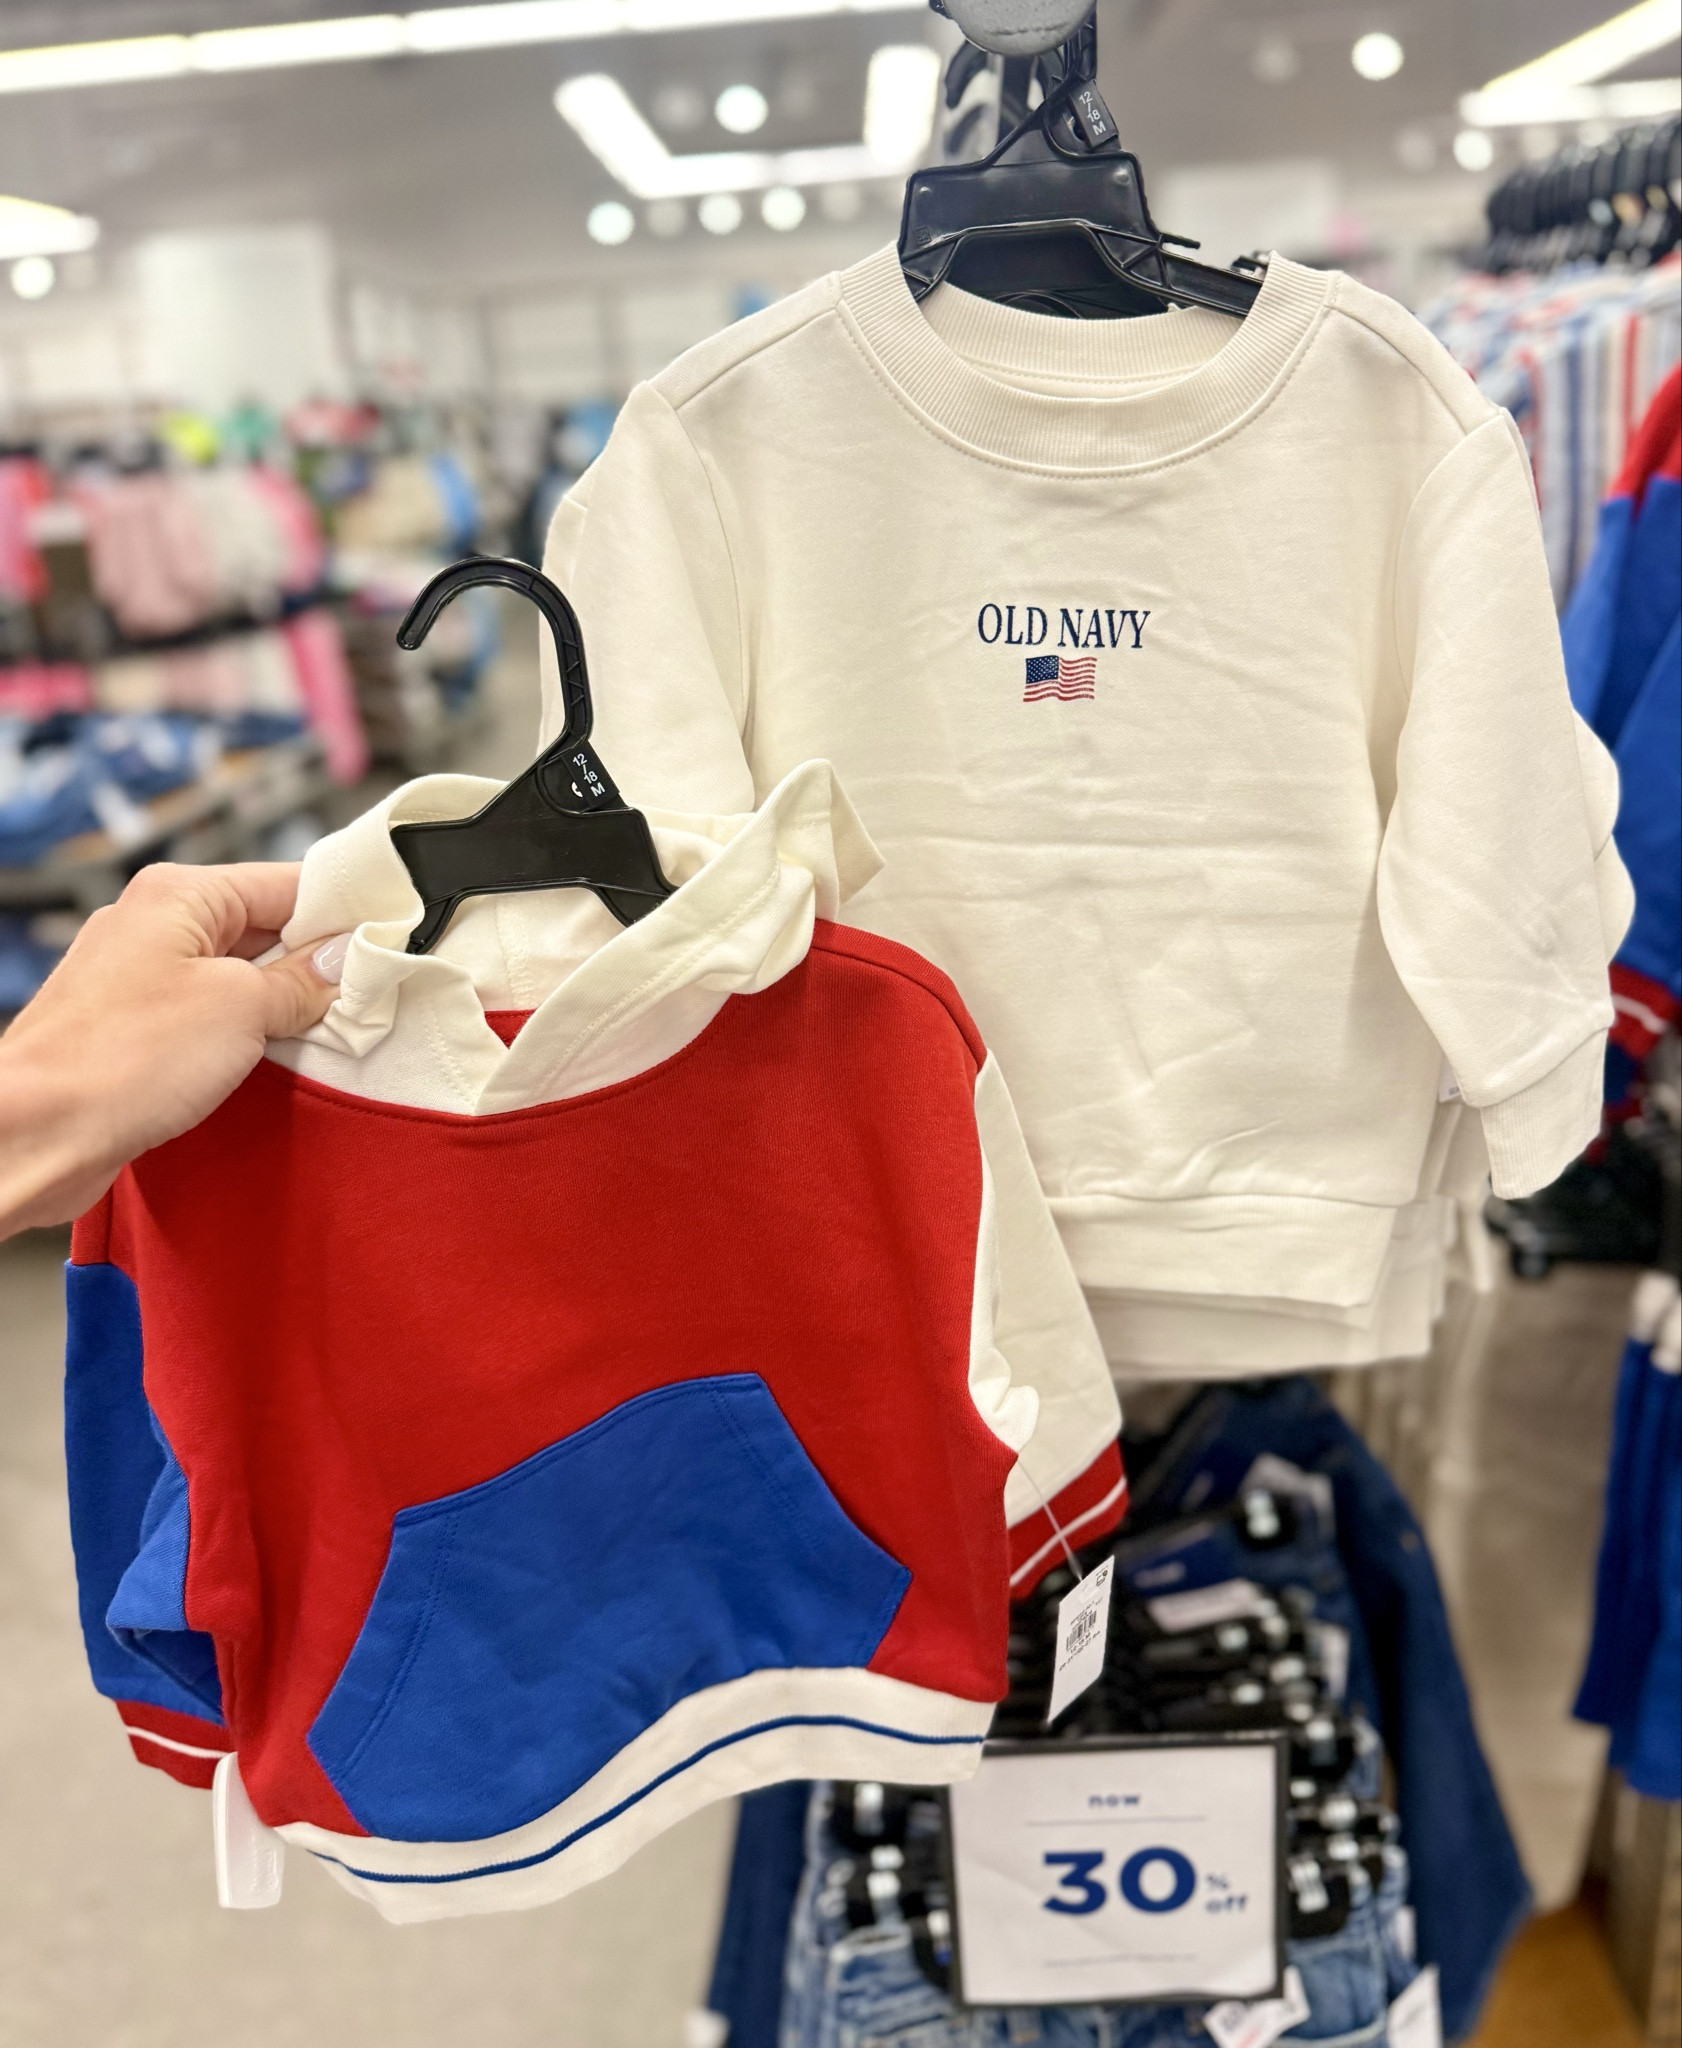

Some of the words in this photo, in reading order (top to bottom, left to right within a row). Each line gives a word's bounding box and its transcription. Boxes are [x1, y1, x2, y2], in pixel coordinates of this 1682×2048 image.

[1079, 91, 1093, 105] 12
[1087, 109, 1101, 122] 18
[1092, 121, 1106, 135] M
[977, 603, 1048, 645] OLD
[1057, 608, 1151, 648] NAVY
[573, 753, 588, 767] 12
[583, 770, 598, 784] 18
[590, 782, 606, 797] M
[1088, 1793, 1141, 1808] now
[1042, 1846, 1197, 1915] 30
[1205, 1895, 1248, 1914] off
